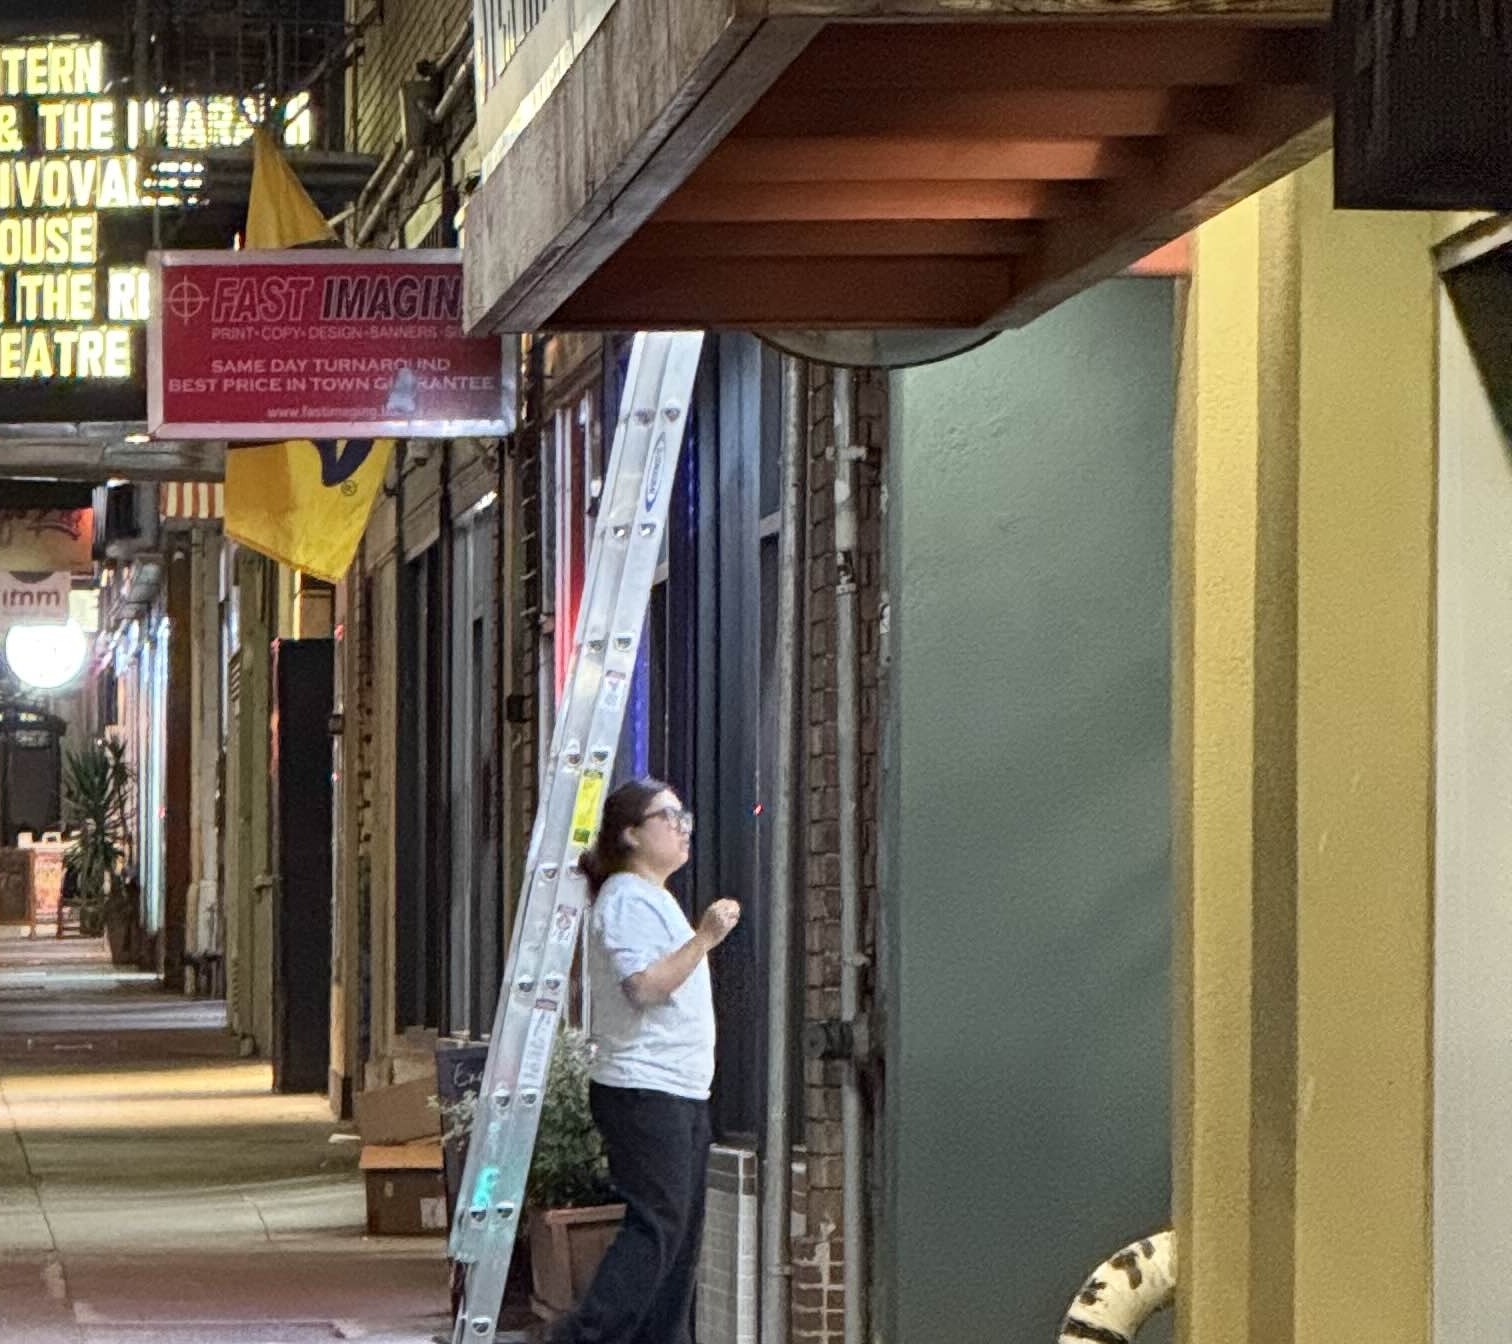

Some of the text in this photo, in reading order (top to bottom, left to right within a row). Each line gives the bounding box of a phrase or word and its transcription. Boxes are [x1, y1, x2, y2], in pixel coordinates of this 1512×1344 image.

[38, 102, 115, 152] THE
[17, 269, 95, 322] THE
[211, 276, 314, 322] FAST
[168, 375, 496, 393] BEST PRICE IN TOWN GRANTEE
[212, 359, 266, 374] SAME
[271, 359, 309, 373] DAY
